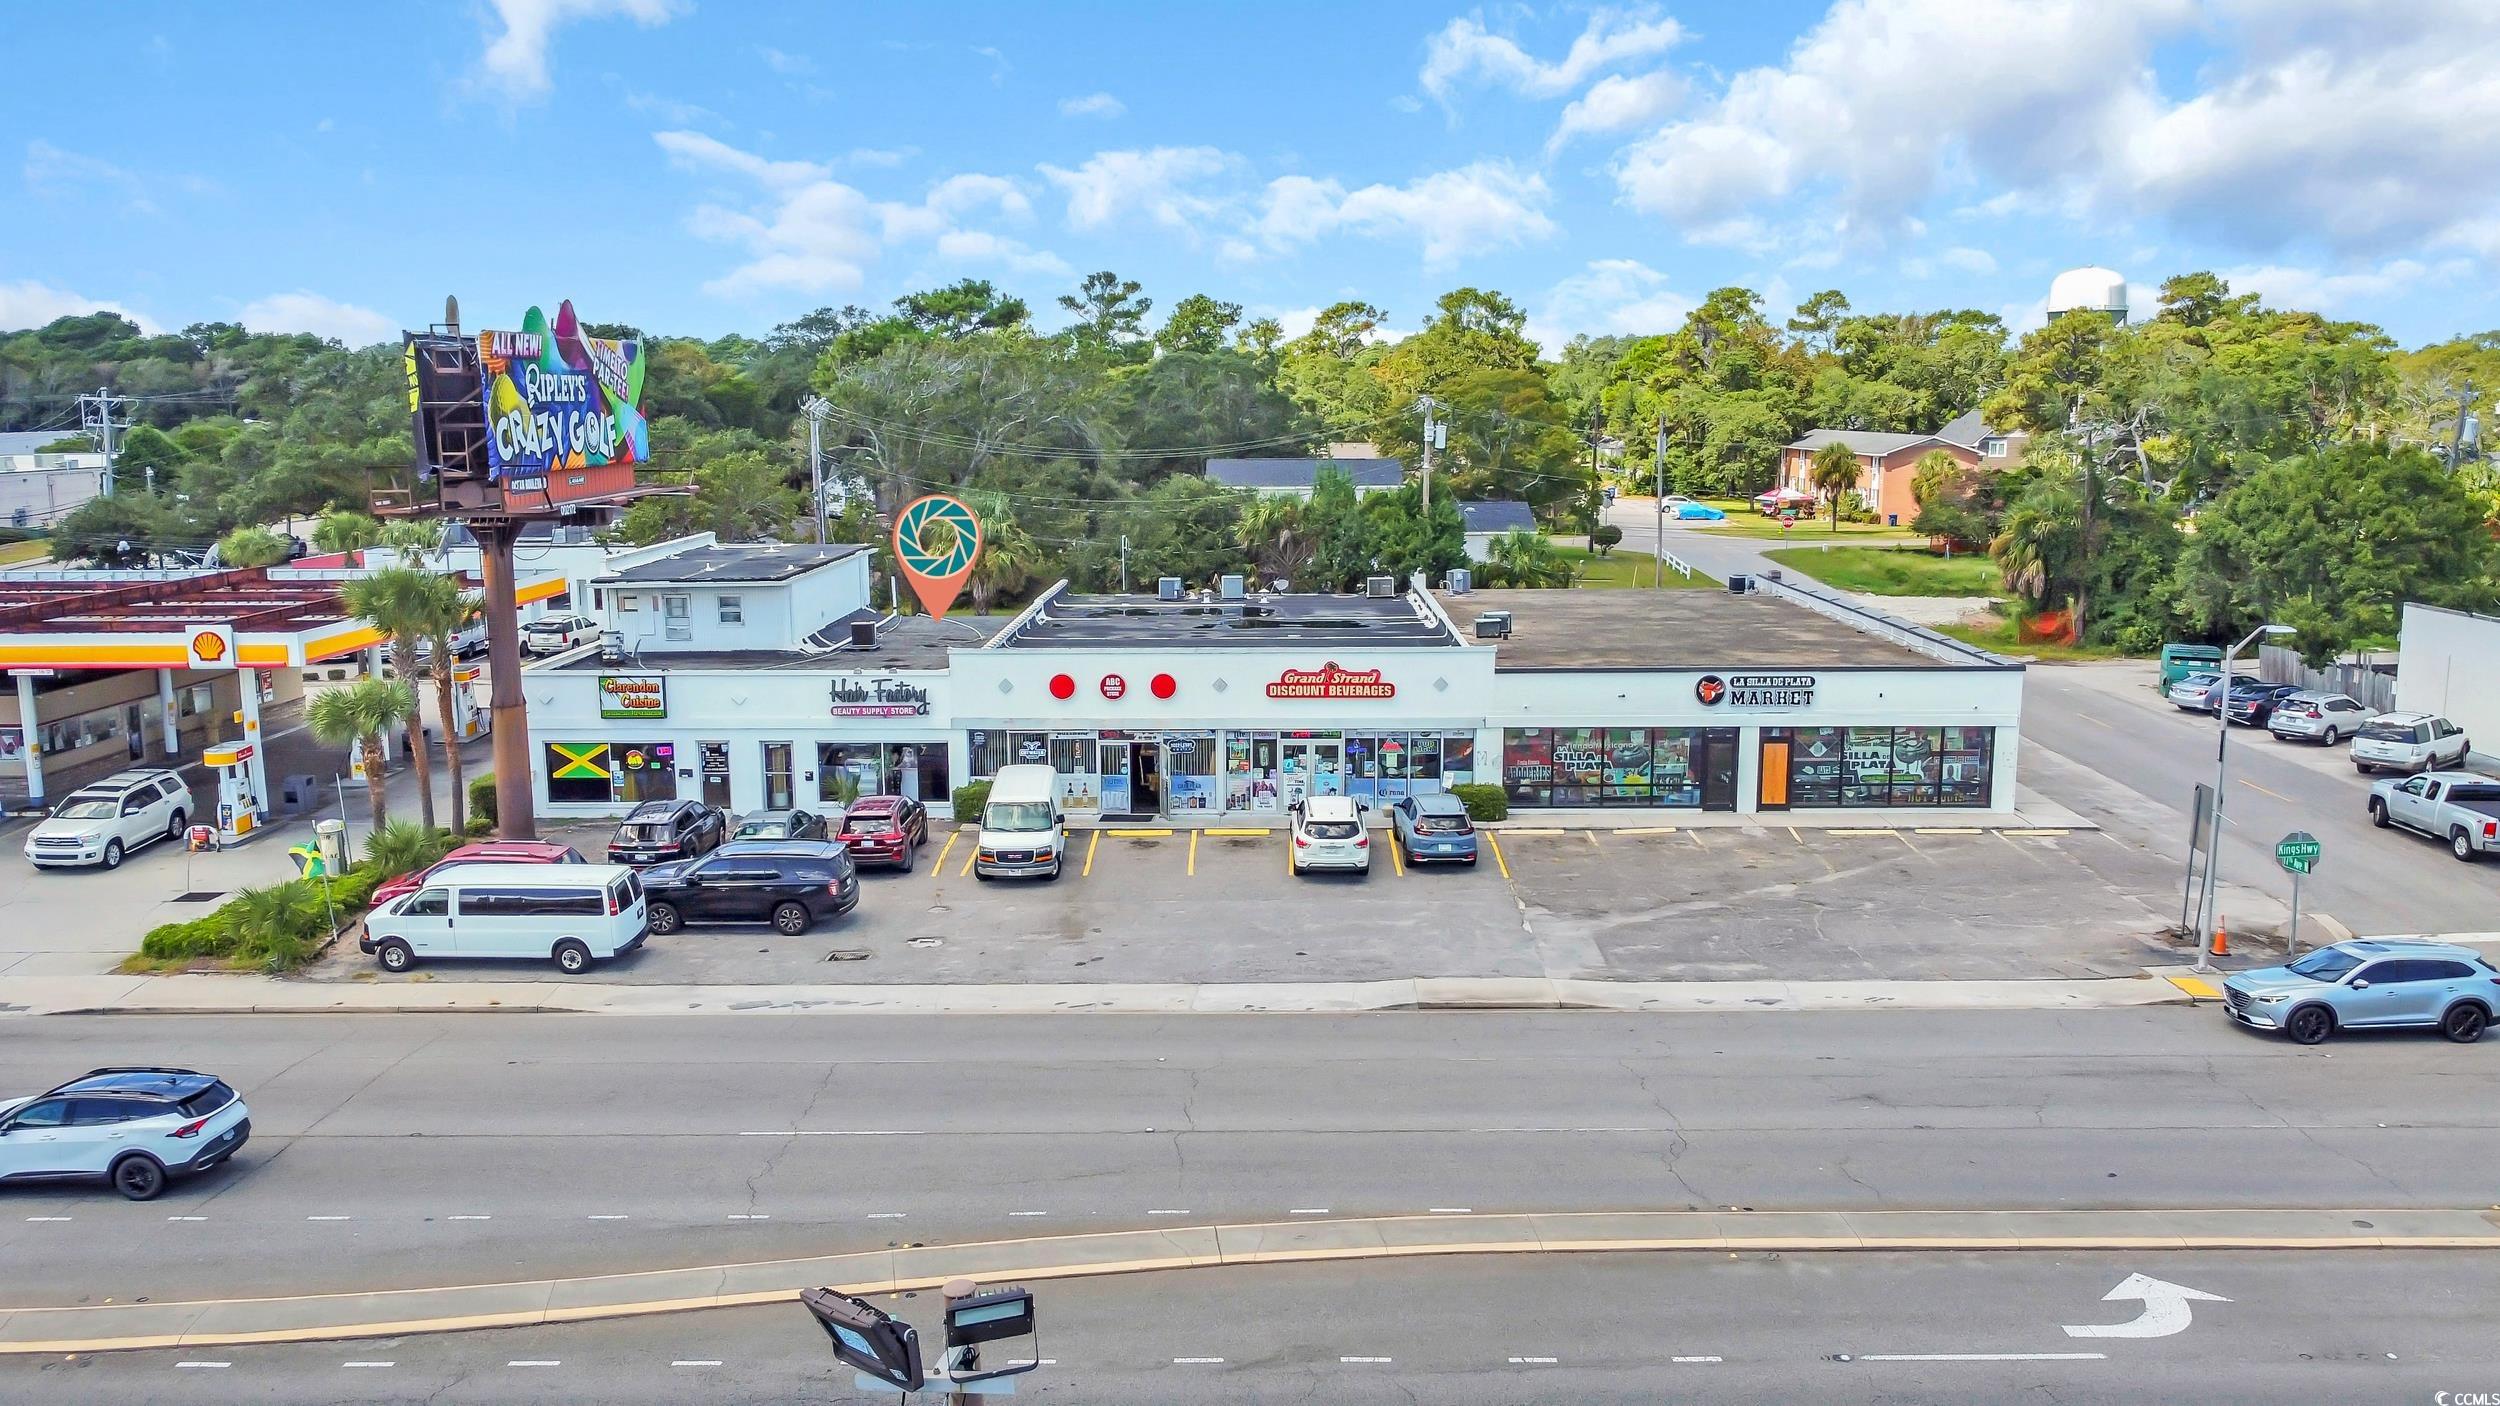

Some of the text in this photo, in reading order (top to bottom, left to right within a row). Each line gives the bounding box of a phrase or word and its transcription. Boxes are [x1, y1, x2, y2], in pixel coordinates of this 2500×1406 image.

[491, 332, 542, 357] ALL NEW!
[525, 363, 586, 408] RIPLEY'S
[592, 359, 629, 402] PAR-TEE!
[496, 409, 617, 461] CRAZY GOLF
[1105, 677, 1121, 686] ABC
[1284, 673, 1376, 684] Grand Strand
[1733, 677, 1812, 686] LA SILLA DE PLATA
[604, 678, 660, 693] Clarendon
[1269, 685, 1392, 696] DISCOUNT BEVERAGES
[621, 694, 661, 708] Cuisine
[829, 678, 931, 715] Hair Factory
[1730, 690, 1814, 705] MARKET
[1554, 752, 1598, 761] SILLA
[1566, 762, 1613, 771] PLATA
[1851, 761, 1897, 769] PLATA
[2279, 843, 2318, 855] Kings Hwy
